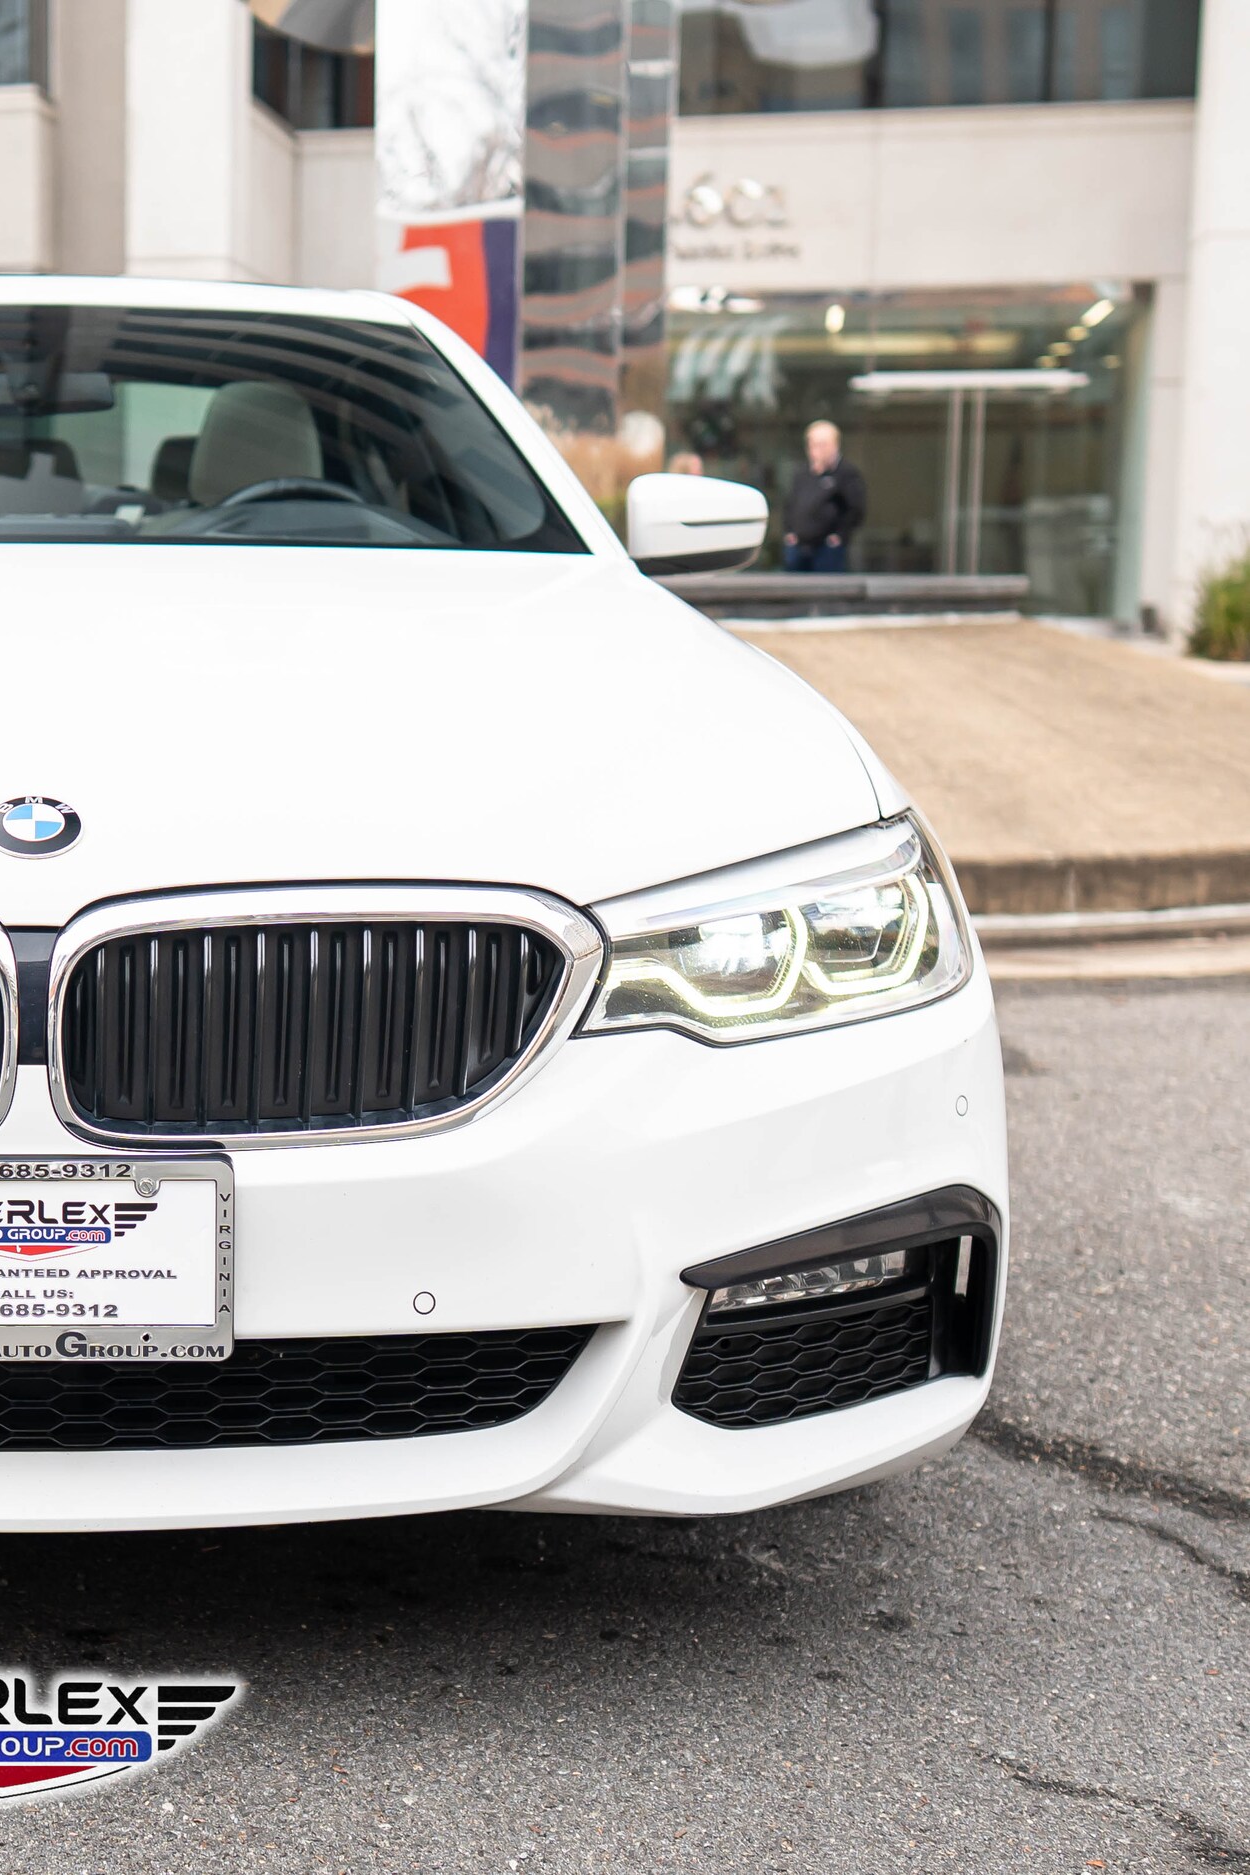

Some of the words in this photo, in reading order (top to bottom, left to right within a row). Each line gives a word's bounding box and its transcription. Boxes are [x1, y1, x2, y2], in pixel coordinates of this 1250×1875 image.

[218, 1193, 232, 1313] VIRGINIA
[76, 1269, 178, 1280] APPROVAL
[42, 1289, 75, 1299] US:
